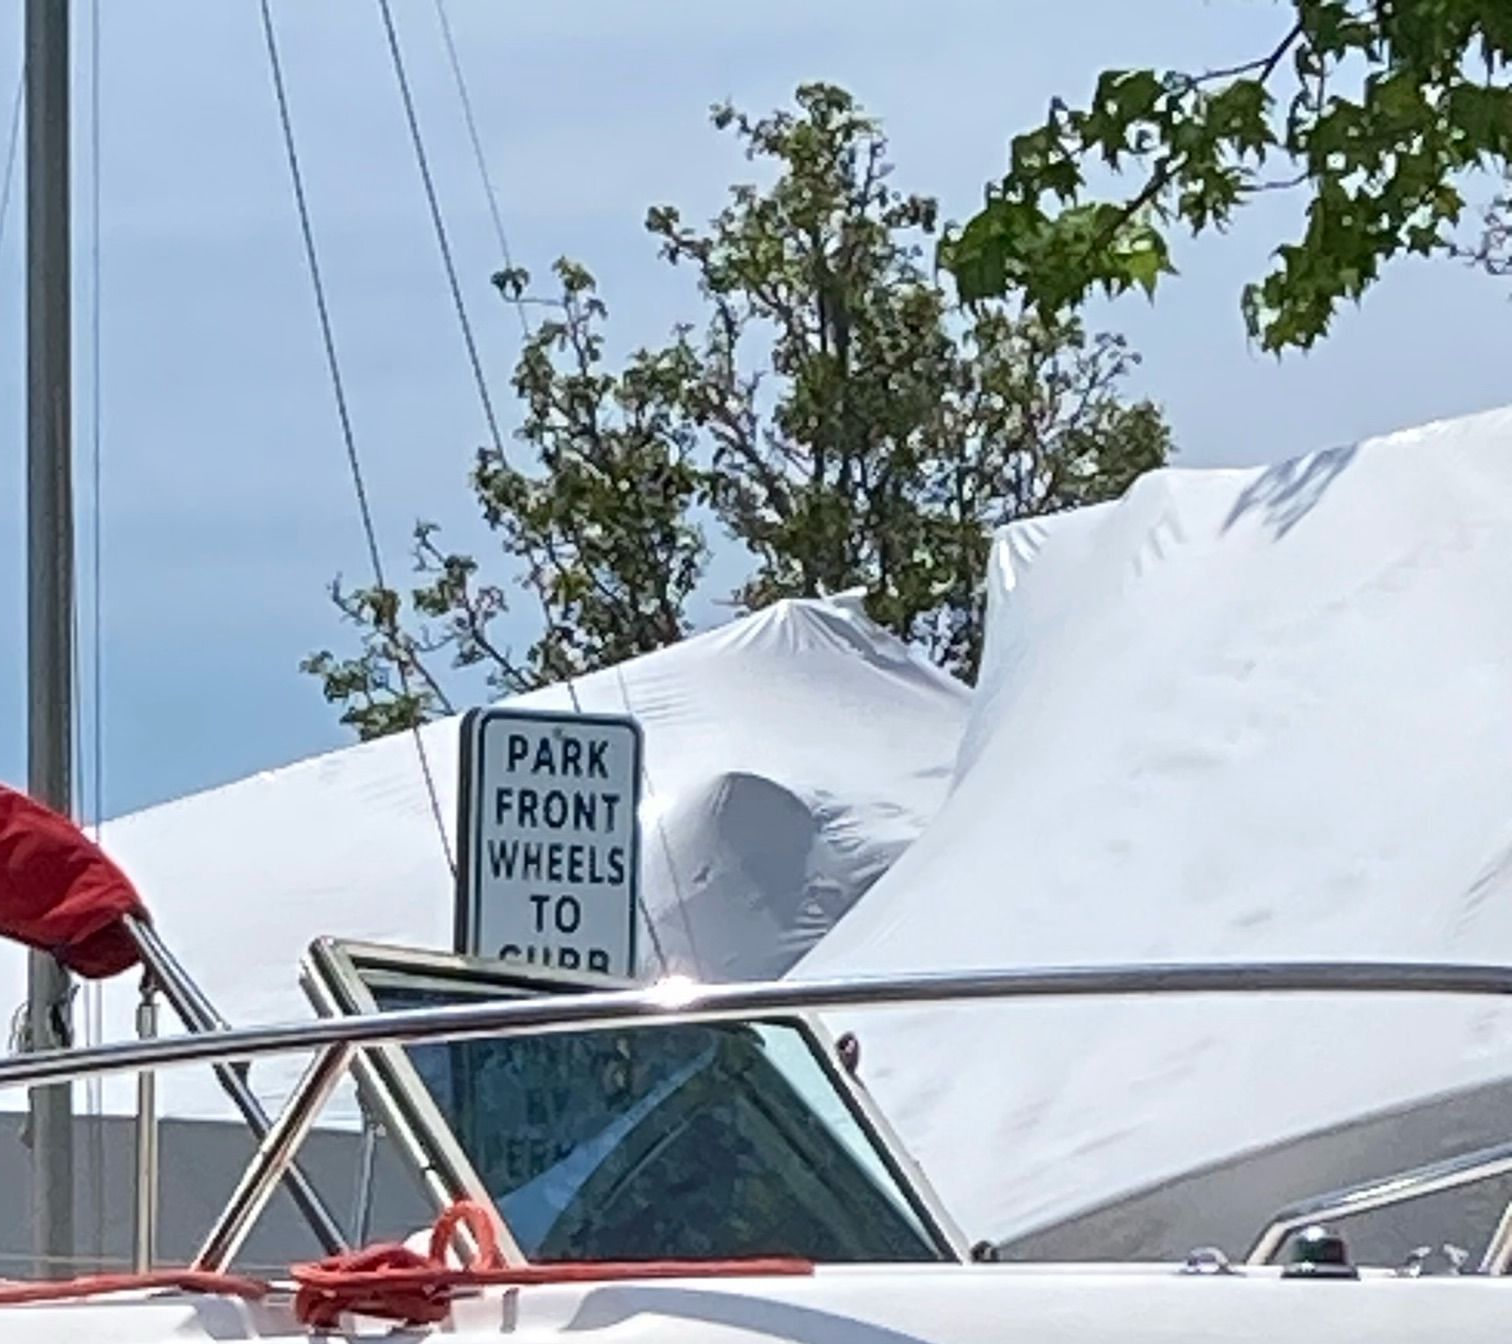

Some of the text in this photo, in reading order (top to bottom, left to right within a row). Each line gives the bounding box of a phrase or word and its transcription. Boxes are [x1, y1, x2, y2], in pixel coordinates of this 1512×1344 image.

[506, 734, 609, 778] PARK
[495, 787, 621, 833] FRONT
[488, 839, 625, 885] WHEELS
[529, 895, 582, 933] TO
